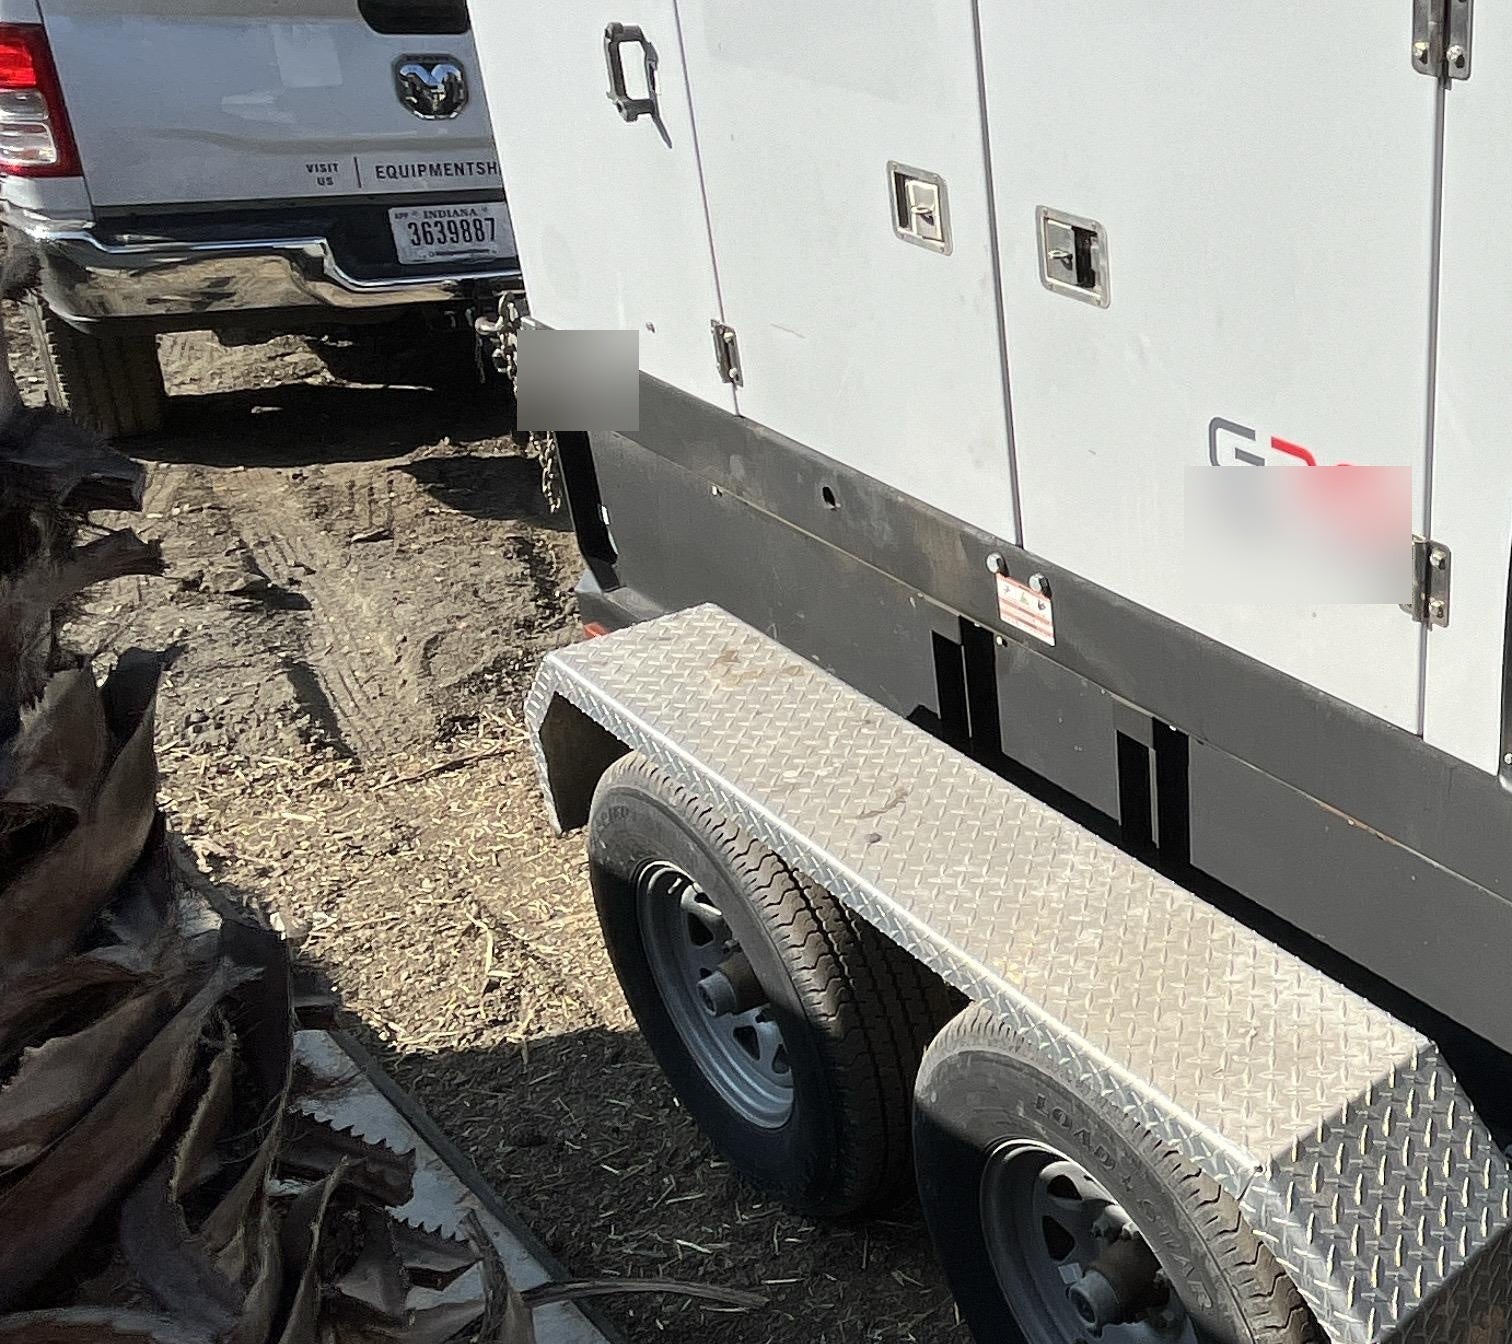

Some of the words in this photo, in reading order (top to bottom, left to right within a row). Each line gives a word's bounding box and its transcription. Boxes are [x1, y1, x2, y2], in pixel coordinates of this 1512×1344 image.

[305, 163, 339, 173] VISIT
[375, 161, 500, 179] EQUIPMENTSH
[317, 177, 334, 186] US
[423, 208, 478, 219] INDIANA
[407, 217, 496, 246] 3639887
[1034, 1092, 1116, 1171] LOAD
[1137, 1198, 1213, 1308] STAR
